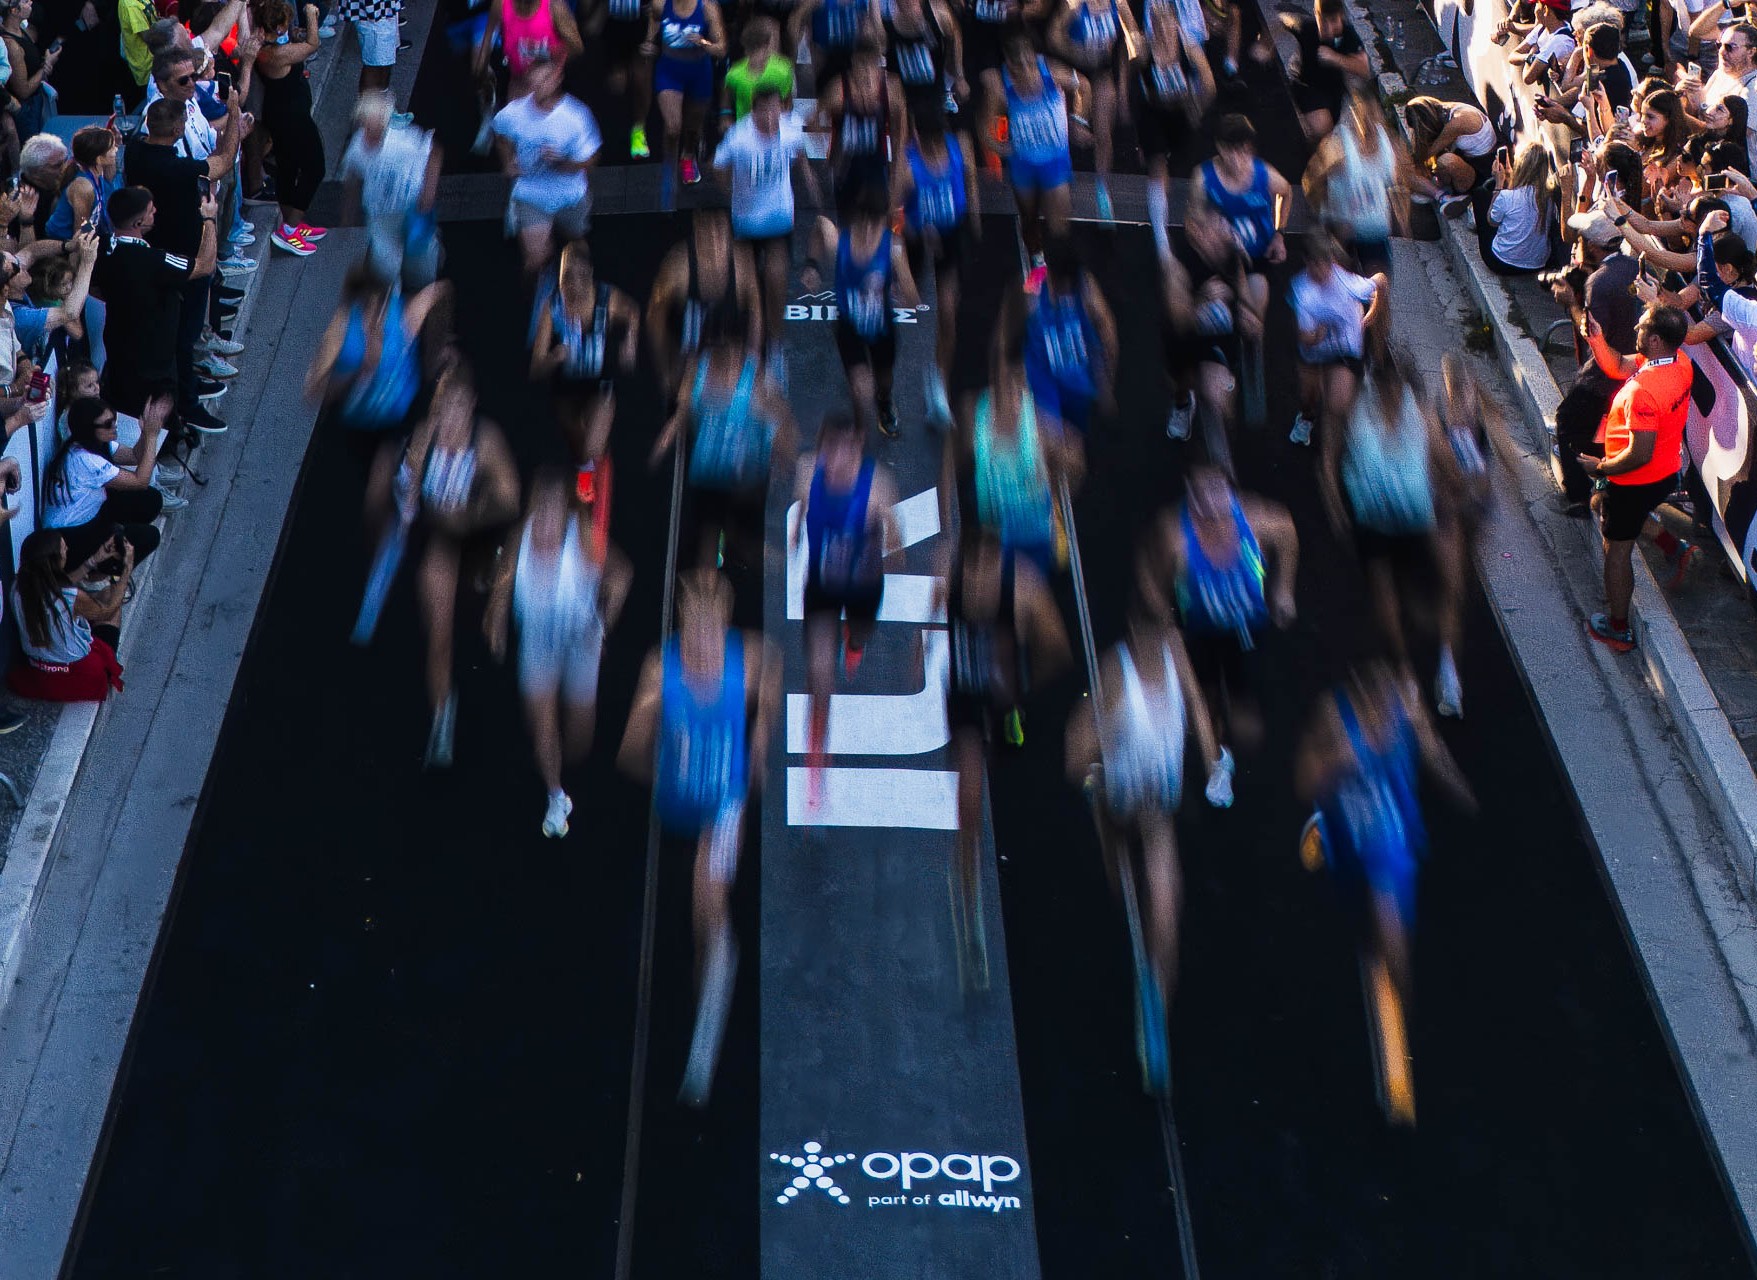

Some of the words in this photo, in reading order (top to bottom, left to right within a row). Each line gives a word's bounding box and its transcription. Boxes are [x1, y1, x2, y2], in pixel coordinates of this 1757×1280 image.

[862, 1152, 1020, 1192] opap
[868, 1195, 907, 1207] part
[912, 1195, 931, 1205] of
[938, 1190, 1020, 1213] allwyn
